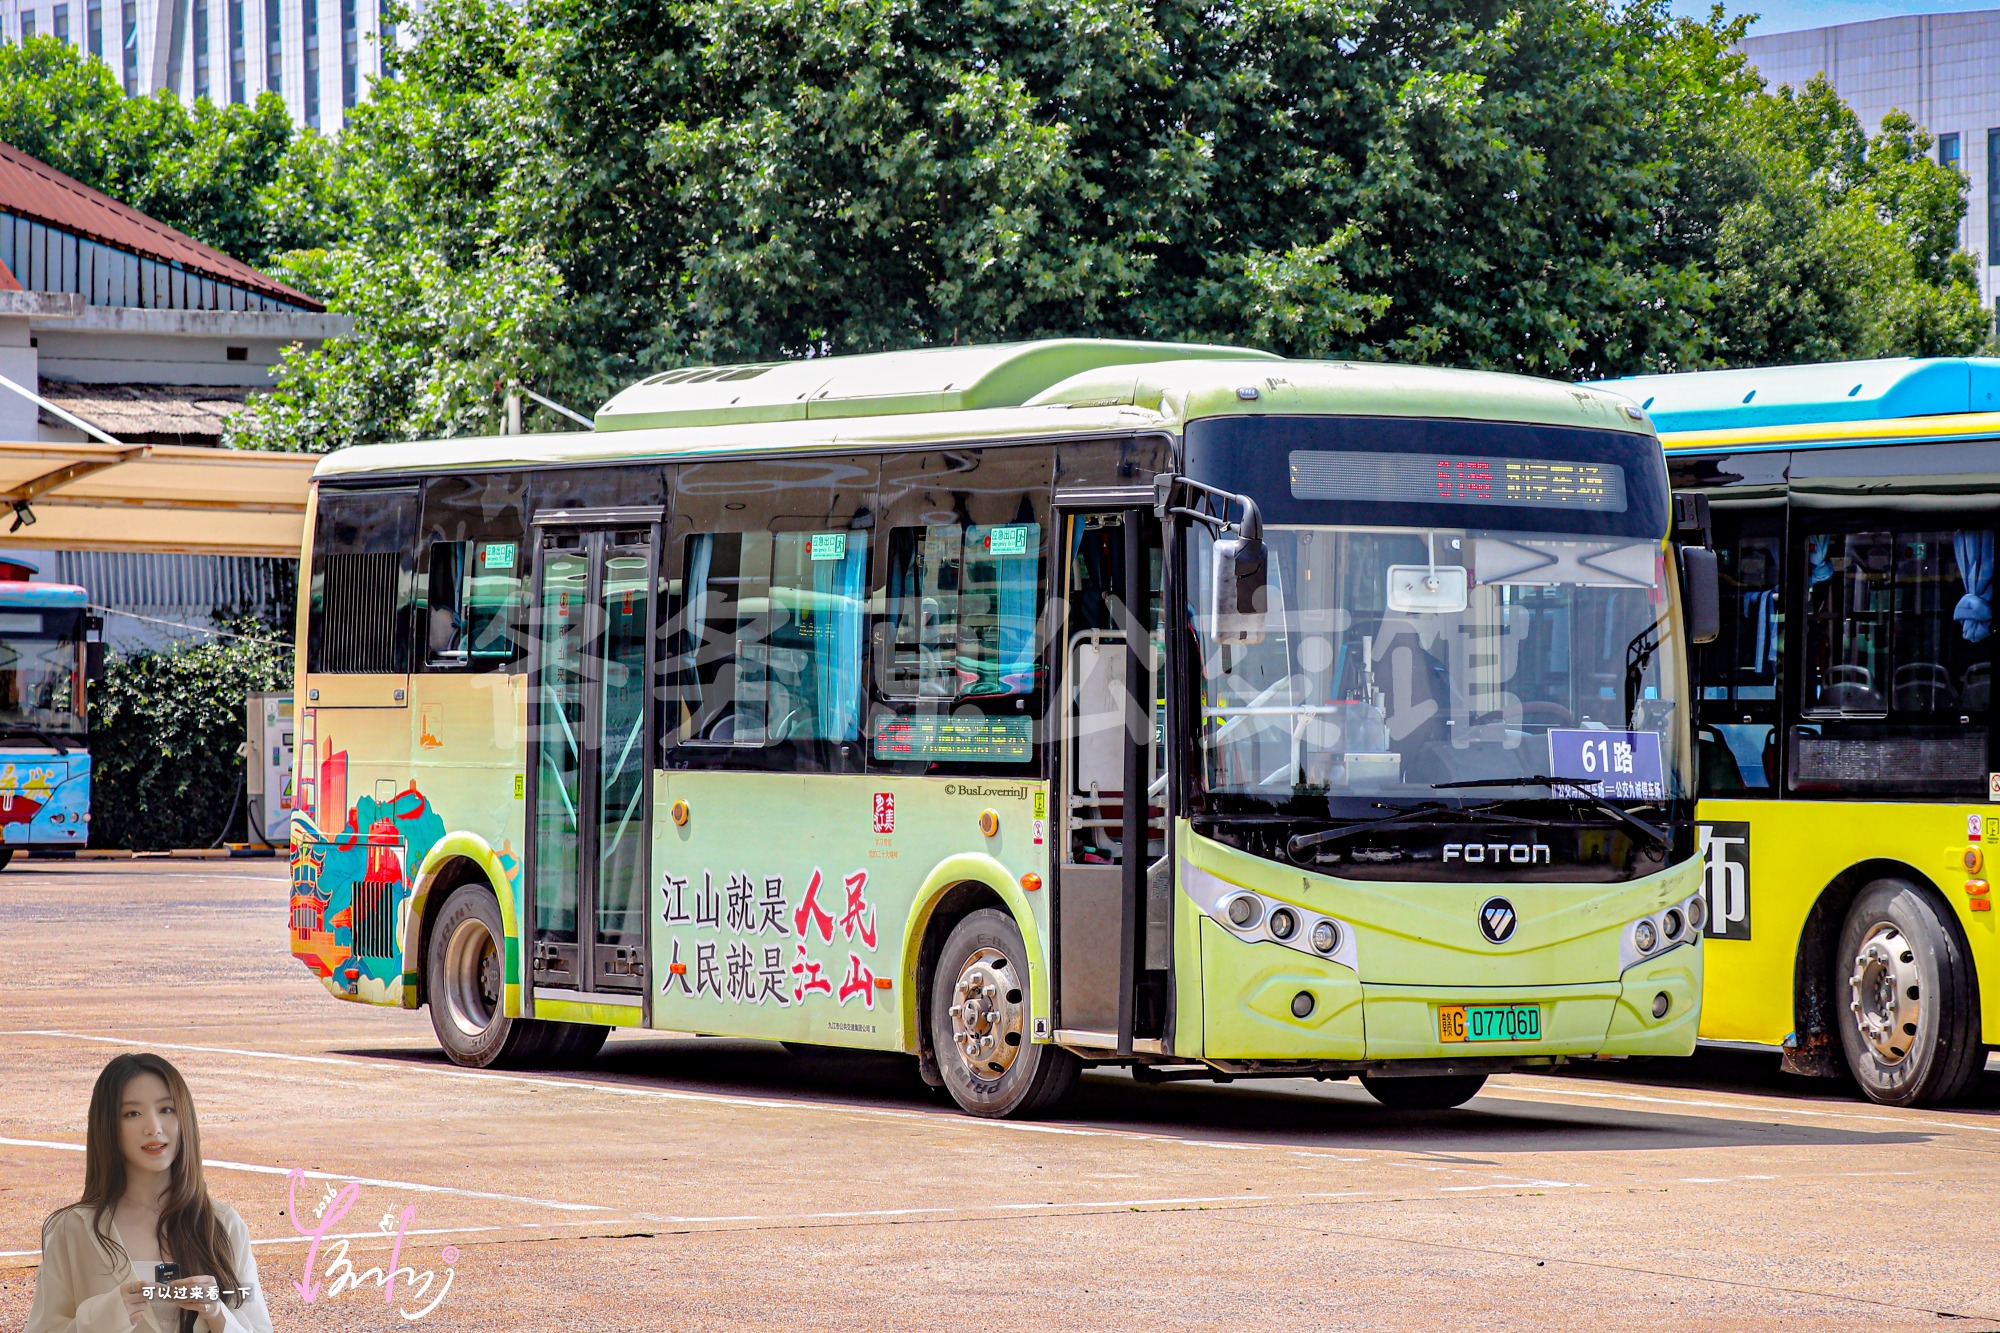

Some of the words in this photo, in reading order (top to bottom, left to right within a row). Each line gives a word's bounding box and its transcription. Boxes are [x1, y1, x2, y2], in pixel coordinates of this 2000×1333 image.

[992, 530, 1015, 540] 应急出口
[1581, 740, 1633, 774] 61路
[1442, 843, 1551, 864] FOTON
[660, 870, 877, 949] 江山就是人民
[660, 938, 875, 1007] 人民就是江山
